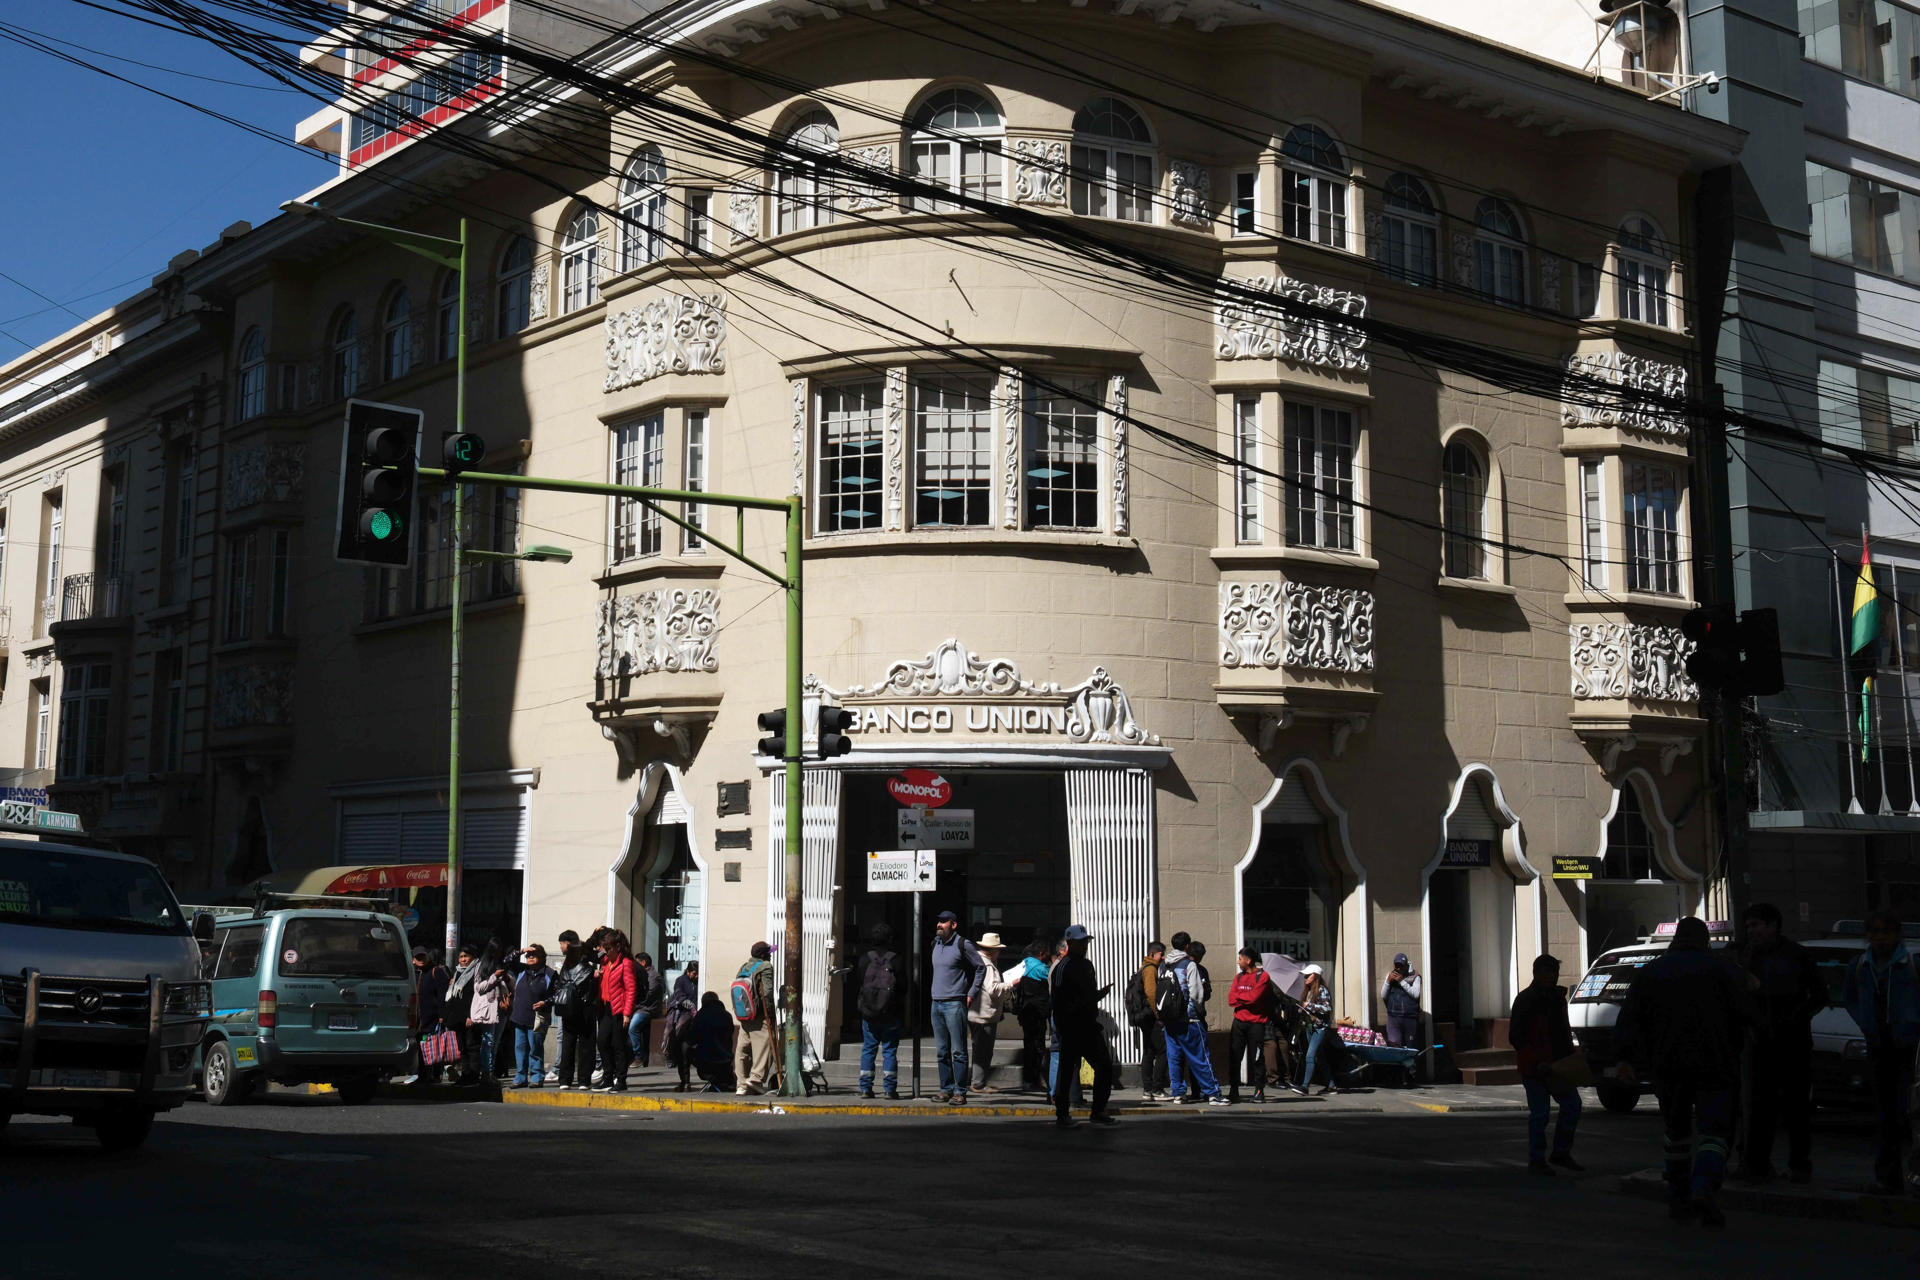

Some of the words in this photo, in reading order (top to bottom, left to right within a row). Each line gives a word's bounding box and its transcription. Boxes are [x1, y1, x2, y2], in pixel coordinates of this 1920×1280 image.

[846, 706, 952, 734] BANCO
[966, 706, 1066, 734] UNION
[9, 787, 46, 797] BANCO
[894, 783, 942, 799] MONOPOL
[6, 804, 34, 825] 284
[46, 813, 77, 829] ARMONIA
[941, 831, 970, 841] LOAYZA
[1450, 842, 1478, 852] BANCO
[872, 871, 908, 881] CAMACHO
